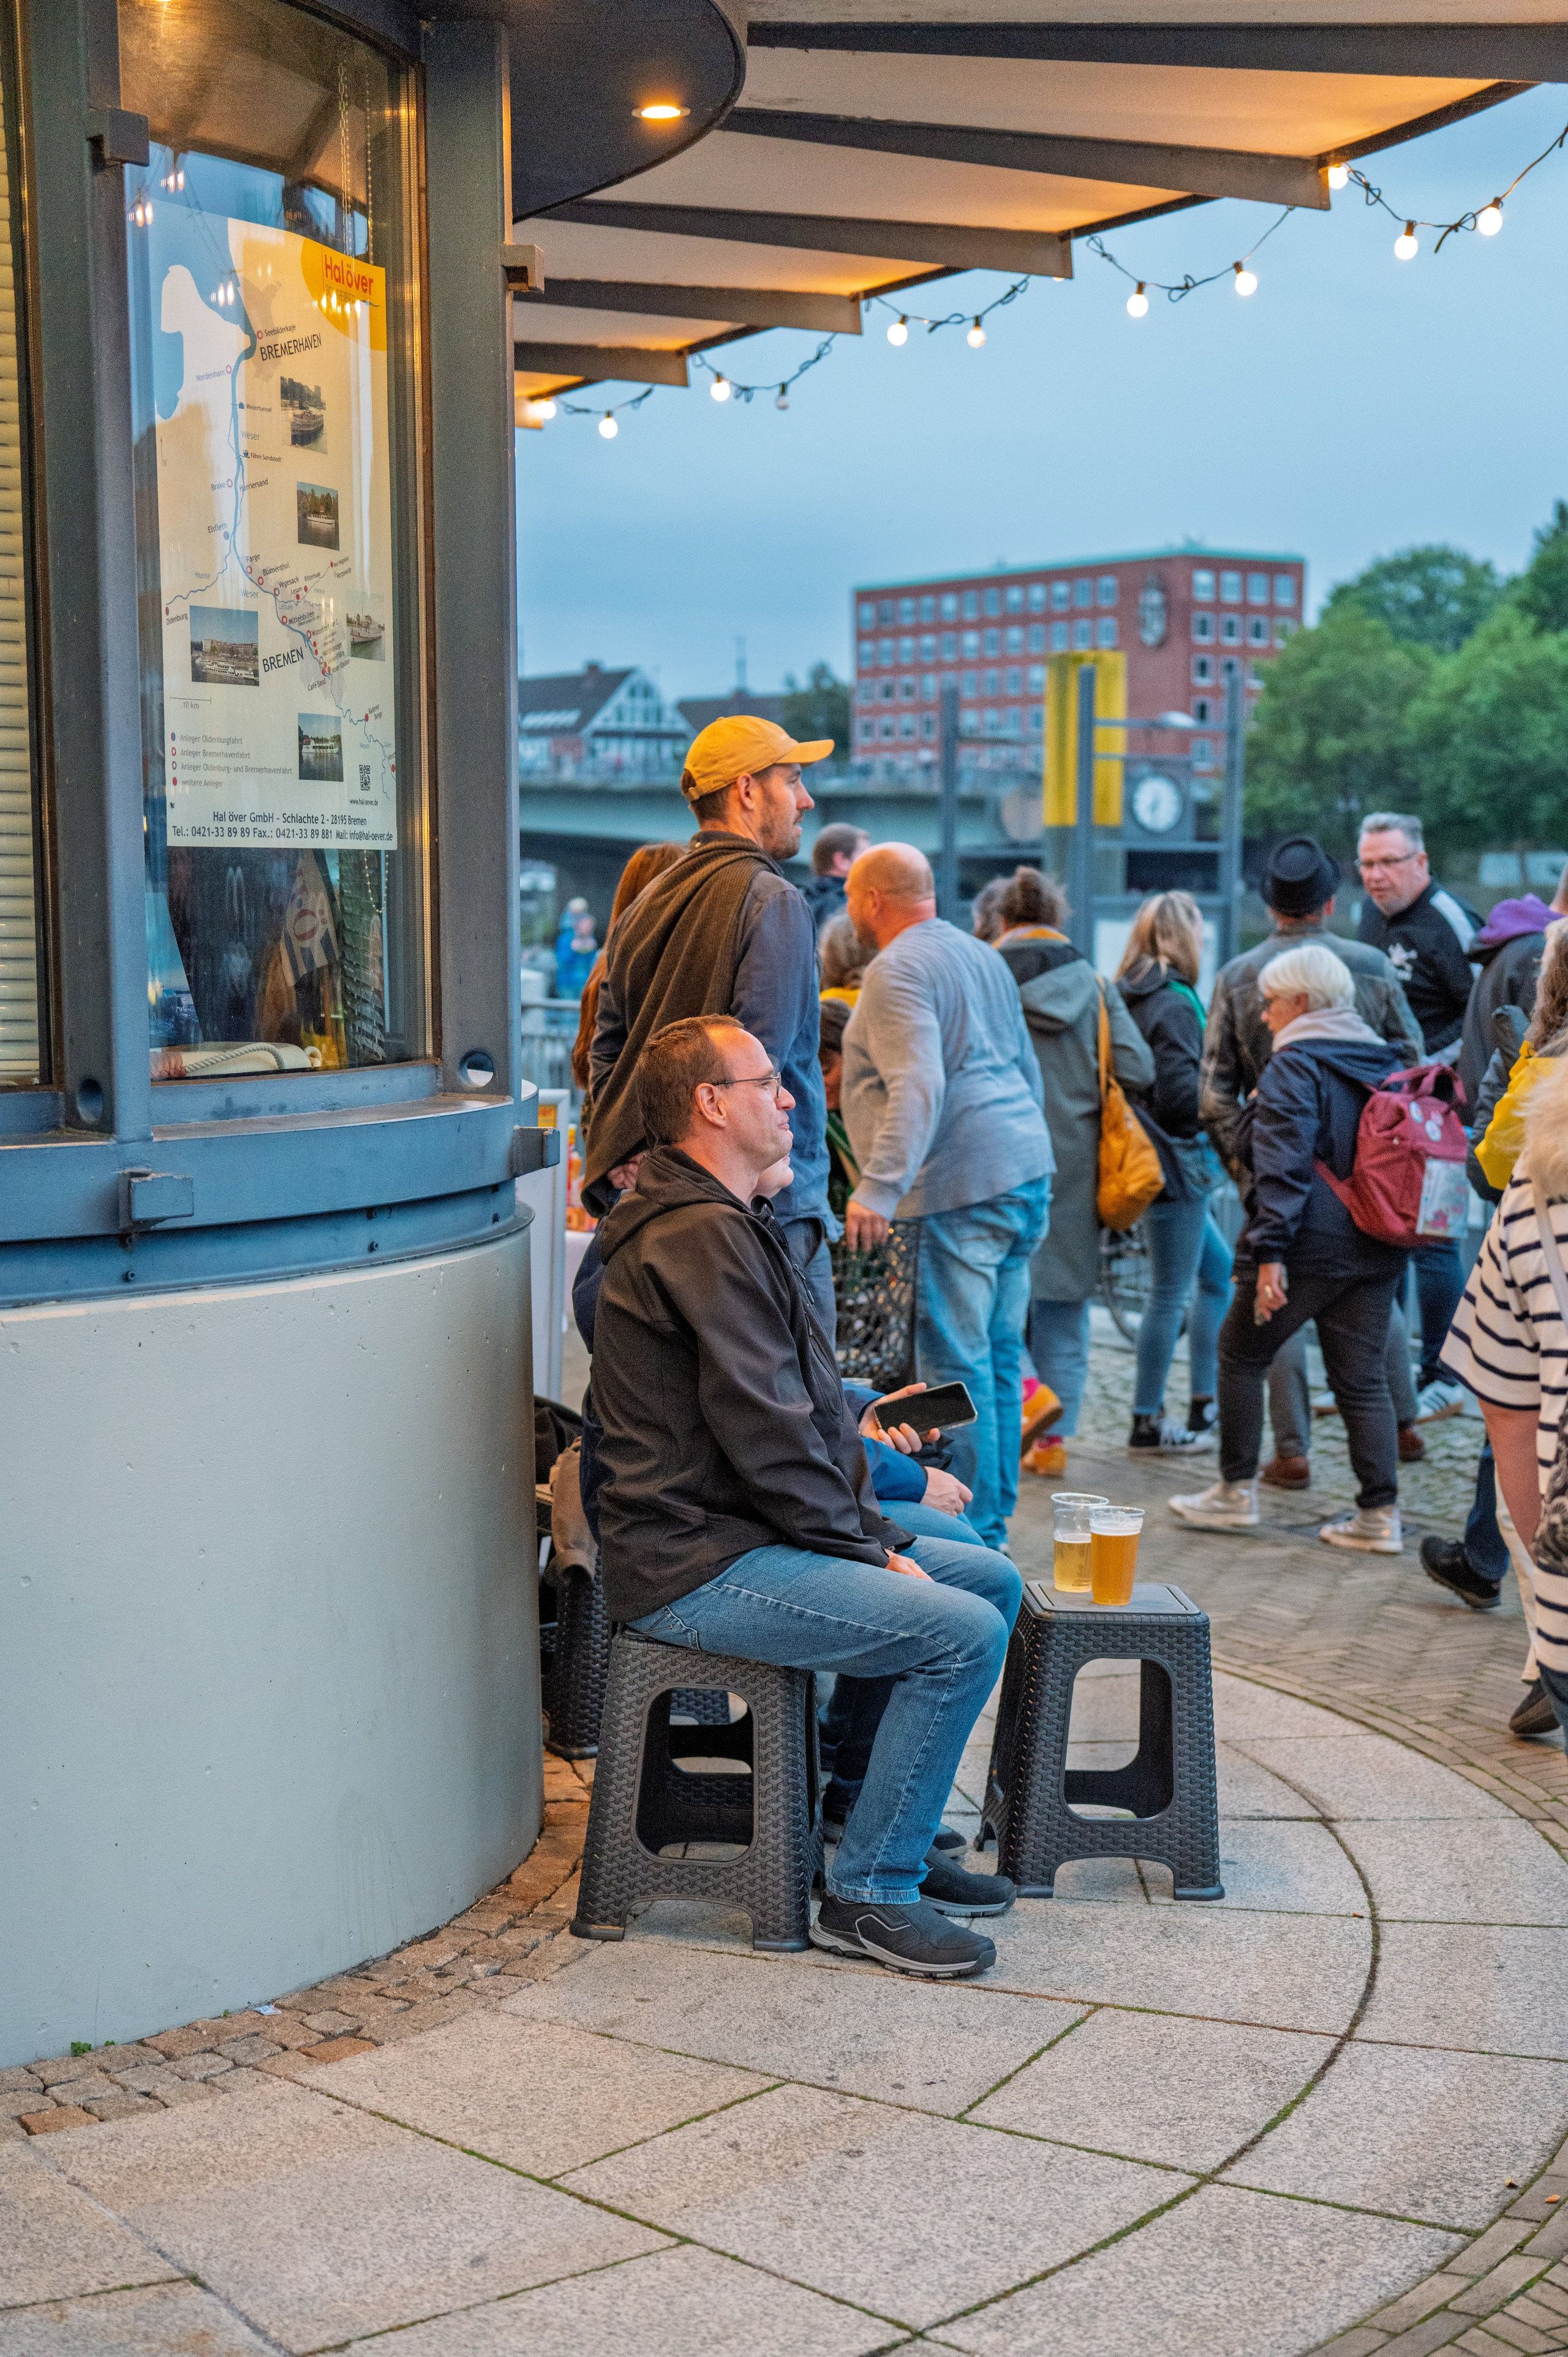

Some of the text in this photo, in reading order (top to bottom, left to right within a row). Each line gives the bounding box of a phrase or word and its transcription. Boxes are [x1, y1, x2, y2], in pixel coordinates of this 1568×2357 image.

[325, 254, 374, 295] Hal över
[265, 324, 296, 337] Seebäderkaje
[260, 333, 322, 361] BREMERHAVEN
[196, 370, 225, 381] Nordenham
[246, 404, 272, 412] Wesertunnel
[241, 430, 260, 441] Weser
[262, 454, 282, 463] Sandstedt
[211, 482, 226, 491] Brake
[239, 478, 268, 491] Harriersand
[208, 522, 227, 533] Elsfleth
[246, 554, 260, 563] Farge
[262, 562, 290, 576] Blumenthal
[278, 576, 300, 588] Vegesack
[240, 589, 259, 598] Weser
[166, 613, 188, 626] Oldenburg
[288, 611, 315, 625] Mittelsbüren
[262, 647, 304, 673] BREMEN
[307, 678, 326, 691] Café Sand
[180, 735, 243, 745] Anleger Oldenburgfahrt
[181, 749, 251, 759] Anleger Bremerhavenfahrt
[181, 763, 202, 772] Anleger
[203, 763, 232, 773] Oldenburg-
[245, 765, 292, 774] Bremerhavenfahrt
[204, 779, 223, 788] Anleger
[213, 811, 226, 822] Hal
[229, 812, 247, 822] över
[250, 812, 274, 823] GmbH
[282, 813, 318, 824] Schlachte
[321, 814, 325, 824] 2
[331, 815, 347, 825] 28195
[348, 815, 367, 826] Bremen
[172, 826, 393, 841] Tel.: 0421-33 89 89 Fax.: 0421-33 89 881 Mail: info@hal-oever.de
